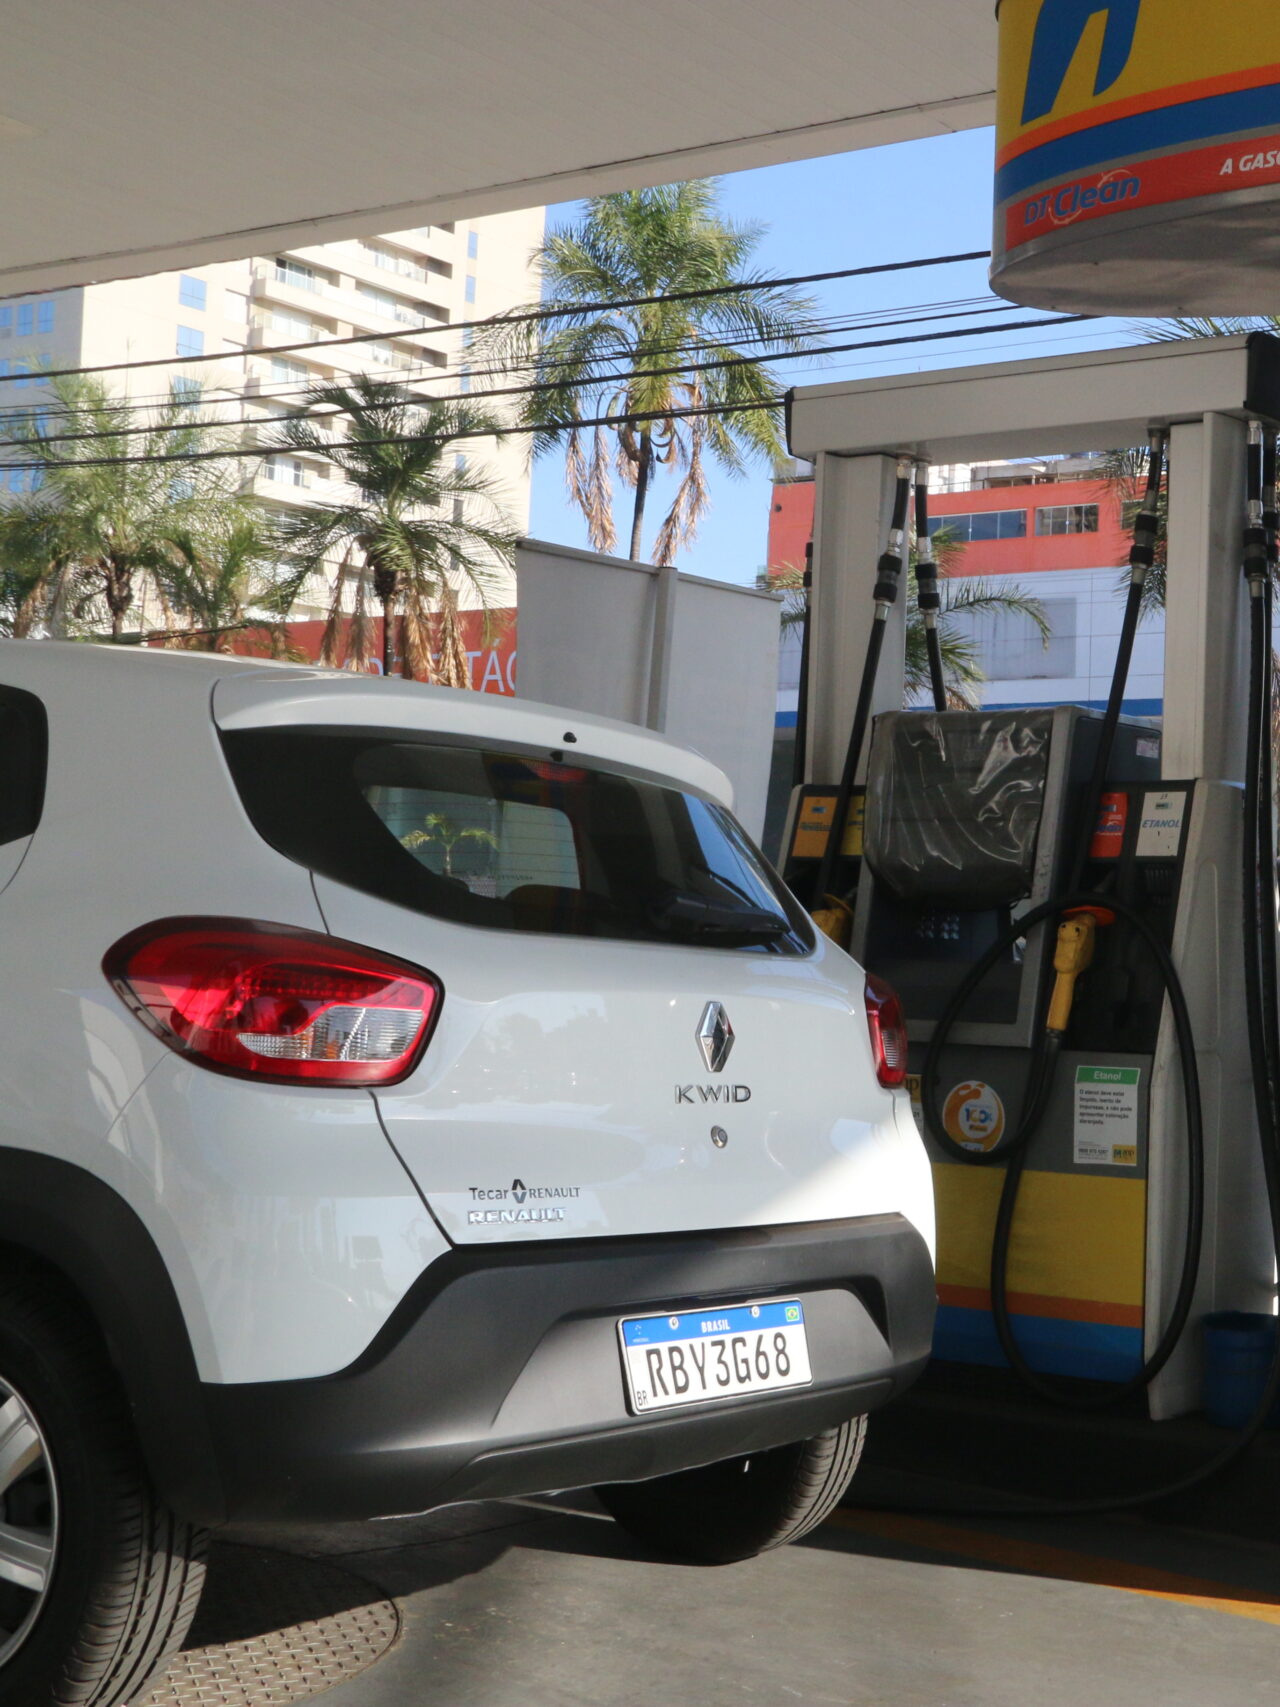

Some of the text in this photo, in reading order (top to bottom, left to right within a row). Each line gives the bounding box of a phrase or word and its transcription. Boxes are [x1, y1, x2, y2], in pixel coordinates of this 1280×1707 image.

[1219, 158, 1233, 175] A
[1054, 177, 1141, 217] Clean
[1142, 819, 1180, 829] ETANOL
[1093, 1070, 1122, 1080] Etanol
[674, 1084, 752, 1105] KWID
[468, 1187, 581, 1201] Tecar RENAULT
[467, 1207, 567, 1225] RENAULT
[700, 1319, 731, 1333] BRASIL
[645, 1331, 791, 1398] RBY3G68
[636, 1390, 649, 1406] BR
